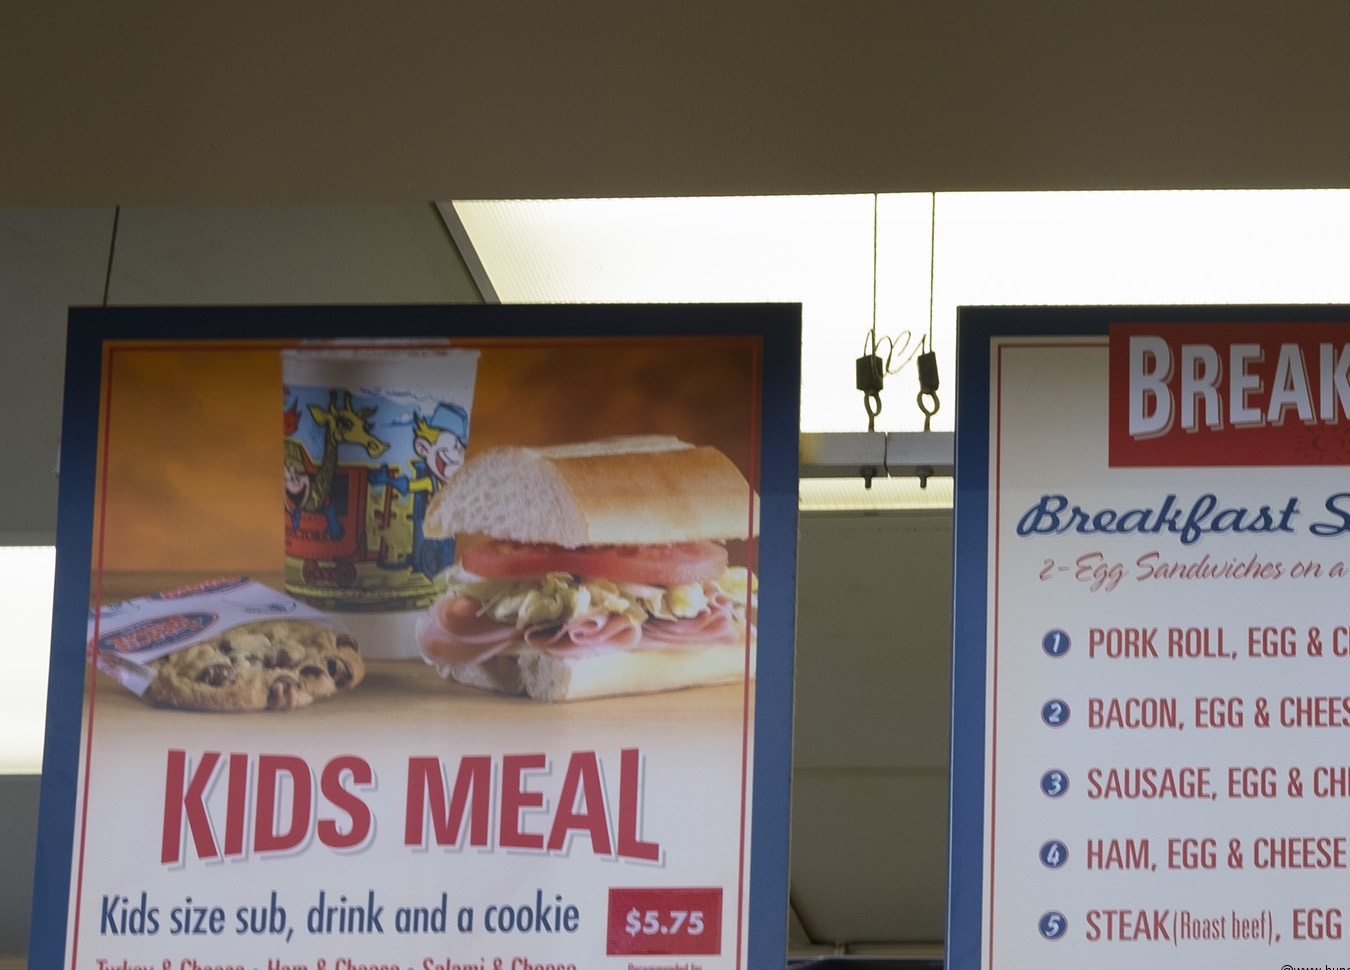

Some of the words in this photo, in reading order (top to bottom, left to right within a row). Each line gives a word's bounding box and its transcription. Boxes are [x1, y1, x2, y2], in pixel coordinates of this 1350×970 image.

[1016, 493, 1300, 546] Breakfast
[1038, 551, 1127, 592] 2-Egg
[1135, 551, 1286, 582] Sandwiches
[1288, 560, 1324, 580] on
[1327, 560, 1347, 580] a
[1052, 632, 1061, 653] 1
[1089, 628, 1159, 658] PORK
[1168, 627, 1238, 660] ROLL,
[1248, 626, 1297, 658] EGG
[1306, 626, 1323, 657] &
[1048, 702, 1062, 723] 2
[1088, 698, 1185, 731] BACON,
[1195, 697, 1244, 728] EGG
[1254, 697, 1270, 728] &
[160, 749, 372, 865] KIDS
[404, 748, 660, 862] MEAL
[100, 891, 160, 935] Kids
[169, 897, 226, 935] size
[235, 891, 294, 943] sub,
[306, 890, 384, 934] drink
[394, 892, 448, 933] and
[457, 907, 474, 933] a
[484, 889, 580, 933] cookie
[625, 907, 705, 937] $5.75
[1045, 914, 1061, 937] 5
[1292, 908, 1342, 940] EGG
